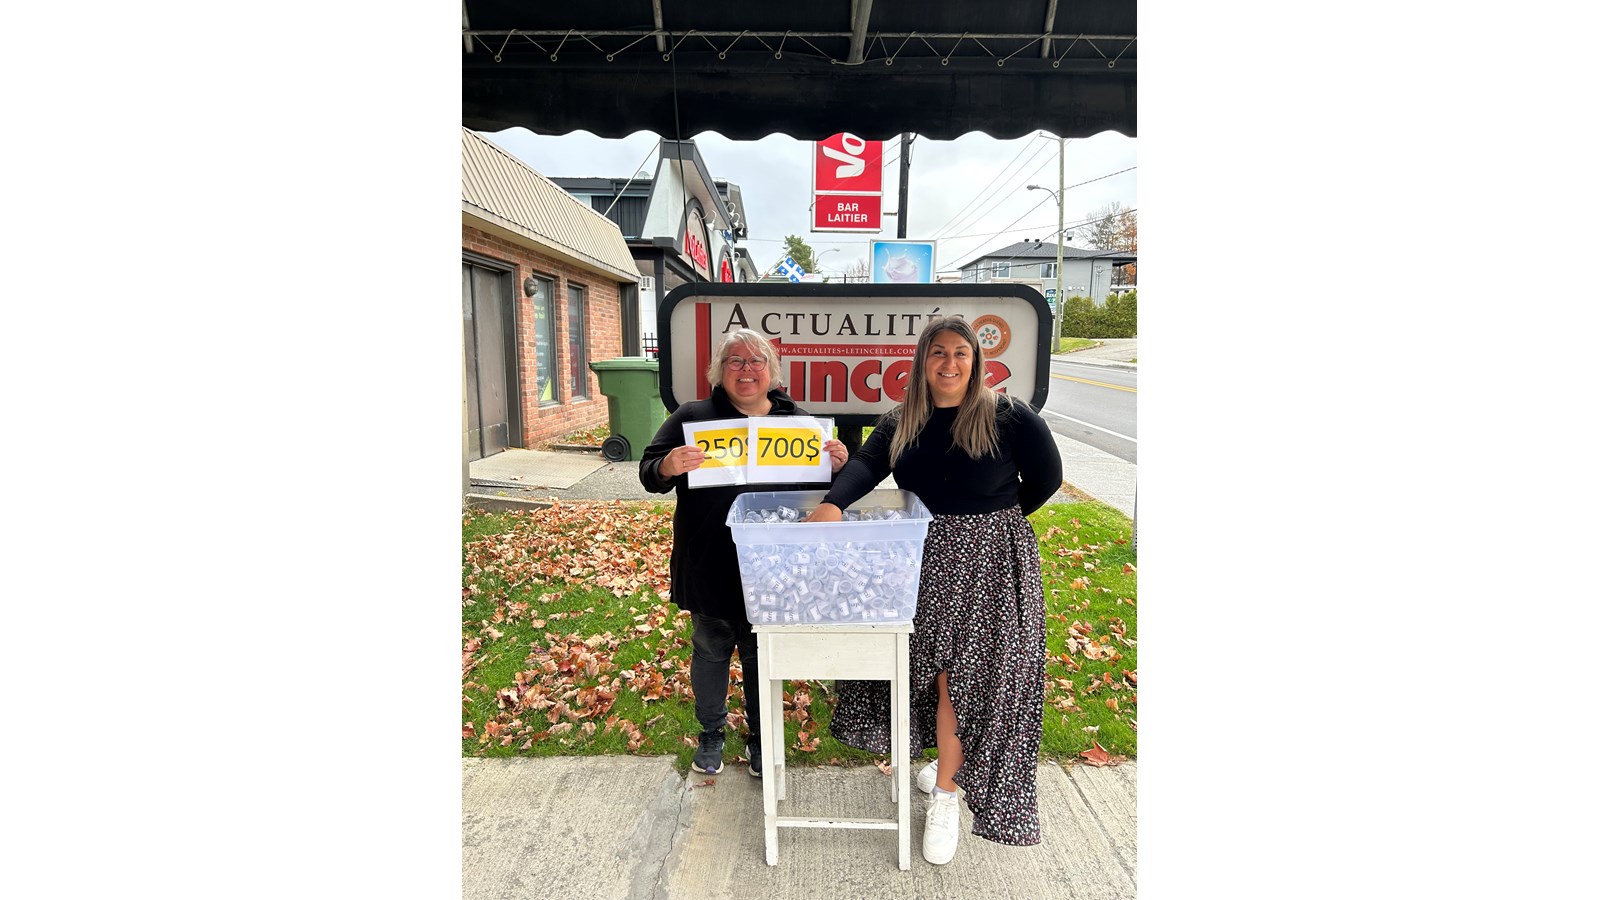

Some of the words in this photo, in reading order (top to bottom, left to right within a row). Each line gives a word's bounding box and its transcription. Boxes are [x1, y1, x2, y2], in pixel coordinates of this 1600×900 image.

[837, 202, 859, 212] BAR
[827, 213, 868, 223] LAITIER
[722, 303, 964, 336] ACTUALIT
[774, 346, 916, 355] WW.ACTUALITES-LETINCELLE.COM
[697, 436, 749, 460] 250
[758, 434, 820, 461] 700$
